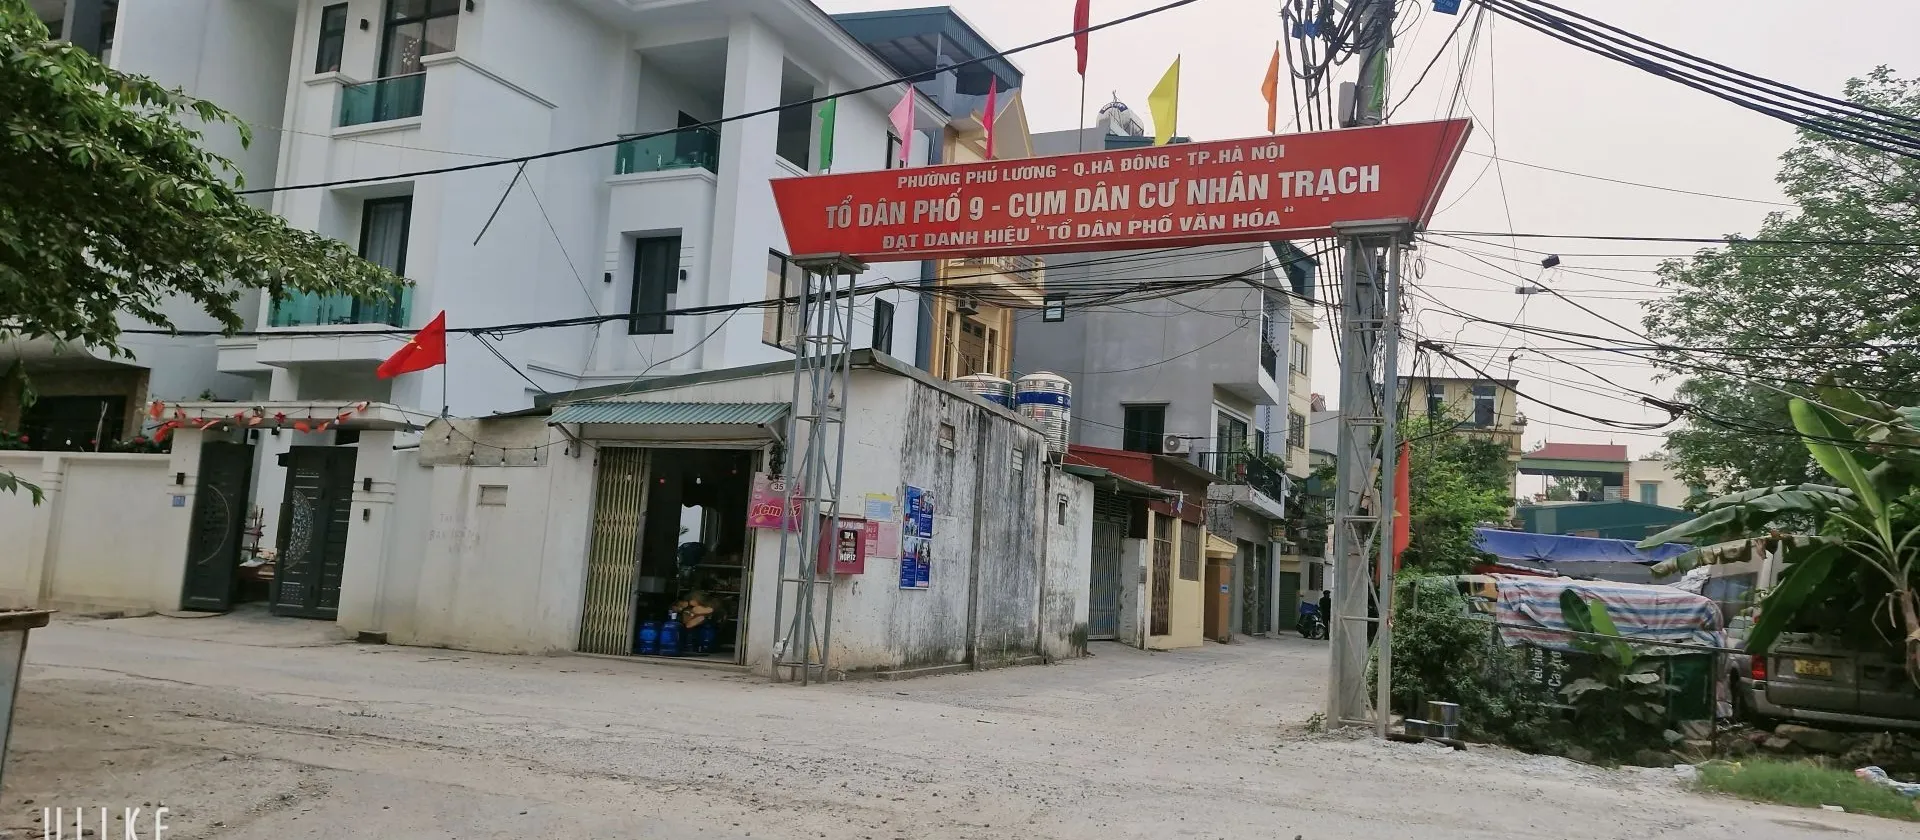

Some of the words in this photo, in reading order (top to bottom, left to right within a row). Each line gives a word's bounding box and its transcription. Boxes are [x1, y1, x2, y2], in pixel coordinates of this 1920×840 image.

[898, 170, 960, 188] PHƯỜNG
[965, 166, 998, 184] PHÚ
[1002, 165, 1057, 181] LƯƠNG
[1073, 156, 1115, 177] Q.HÀ
[1120, 154, 1170, 172] ĐÔNG
[1187, 146, 1244, 166] TP.HÀ
[1251, 142, 1285, 163] NỘI
[825, 195, 853, 229] TỔ
[858, 197, 906, 227] DÂN
[913, 188, 962, 223] PHỐ
[969, 196, 984, 221] 9
[1008, 190, 1067, 223] CỤM
[1074, 181, 1130, 213] DÂN
[1139, 178, 1180, 209] CƯ
[1186, 170, 1269, 205] NHÂN
[1278, 165, 1380, 201] TRẠCH
[882, 234, 919, 251] ĐẠT
[924, 231, 978, 247] DANH
[984, 225, 1030, 246] HIỆU
[1077, 220, 1122, 239] DÂN
[1128, 212, 1173, 235] PHỐ
[1179, 212, 1226, 232] VĂN
[750, 502, 782, 518] Kem
